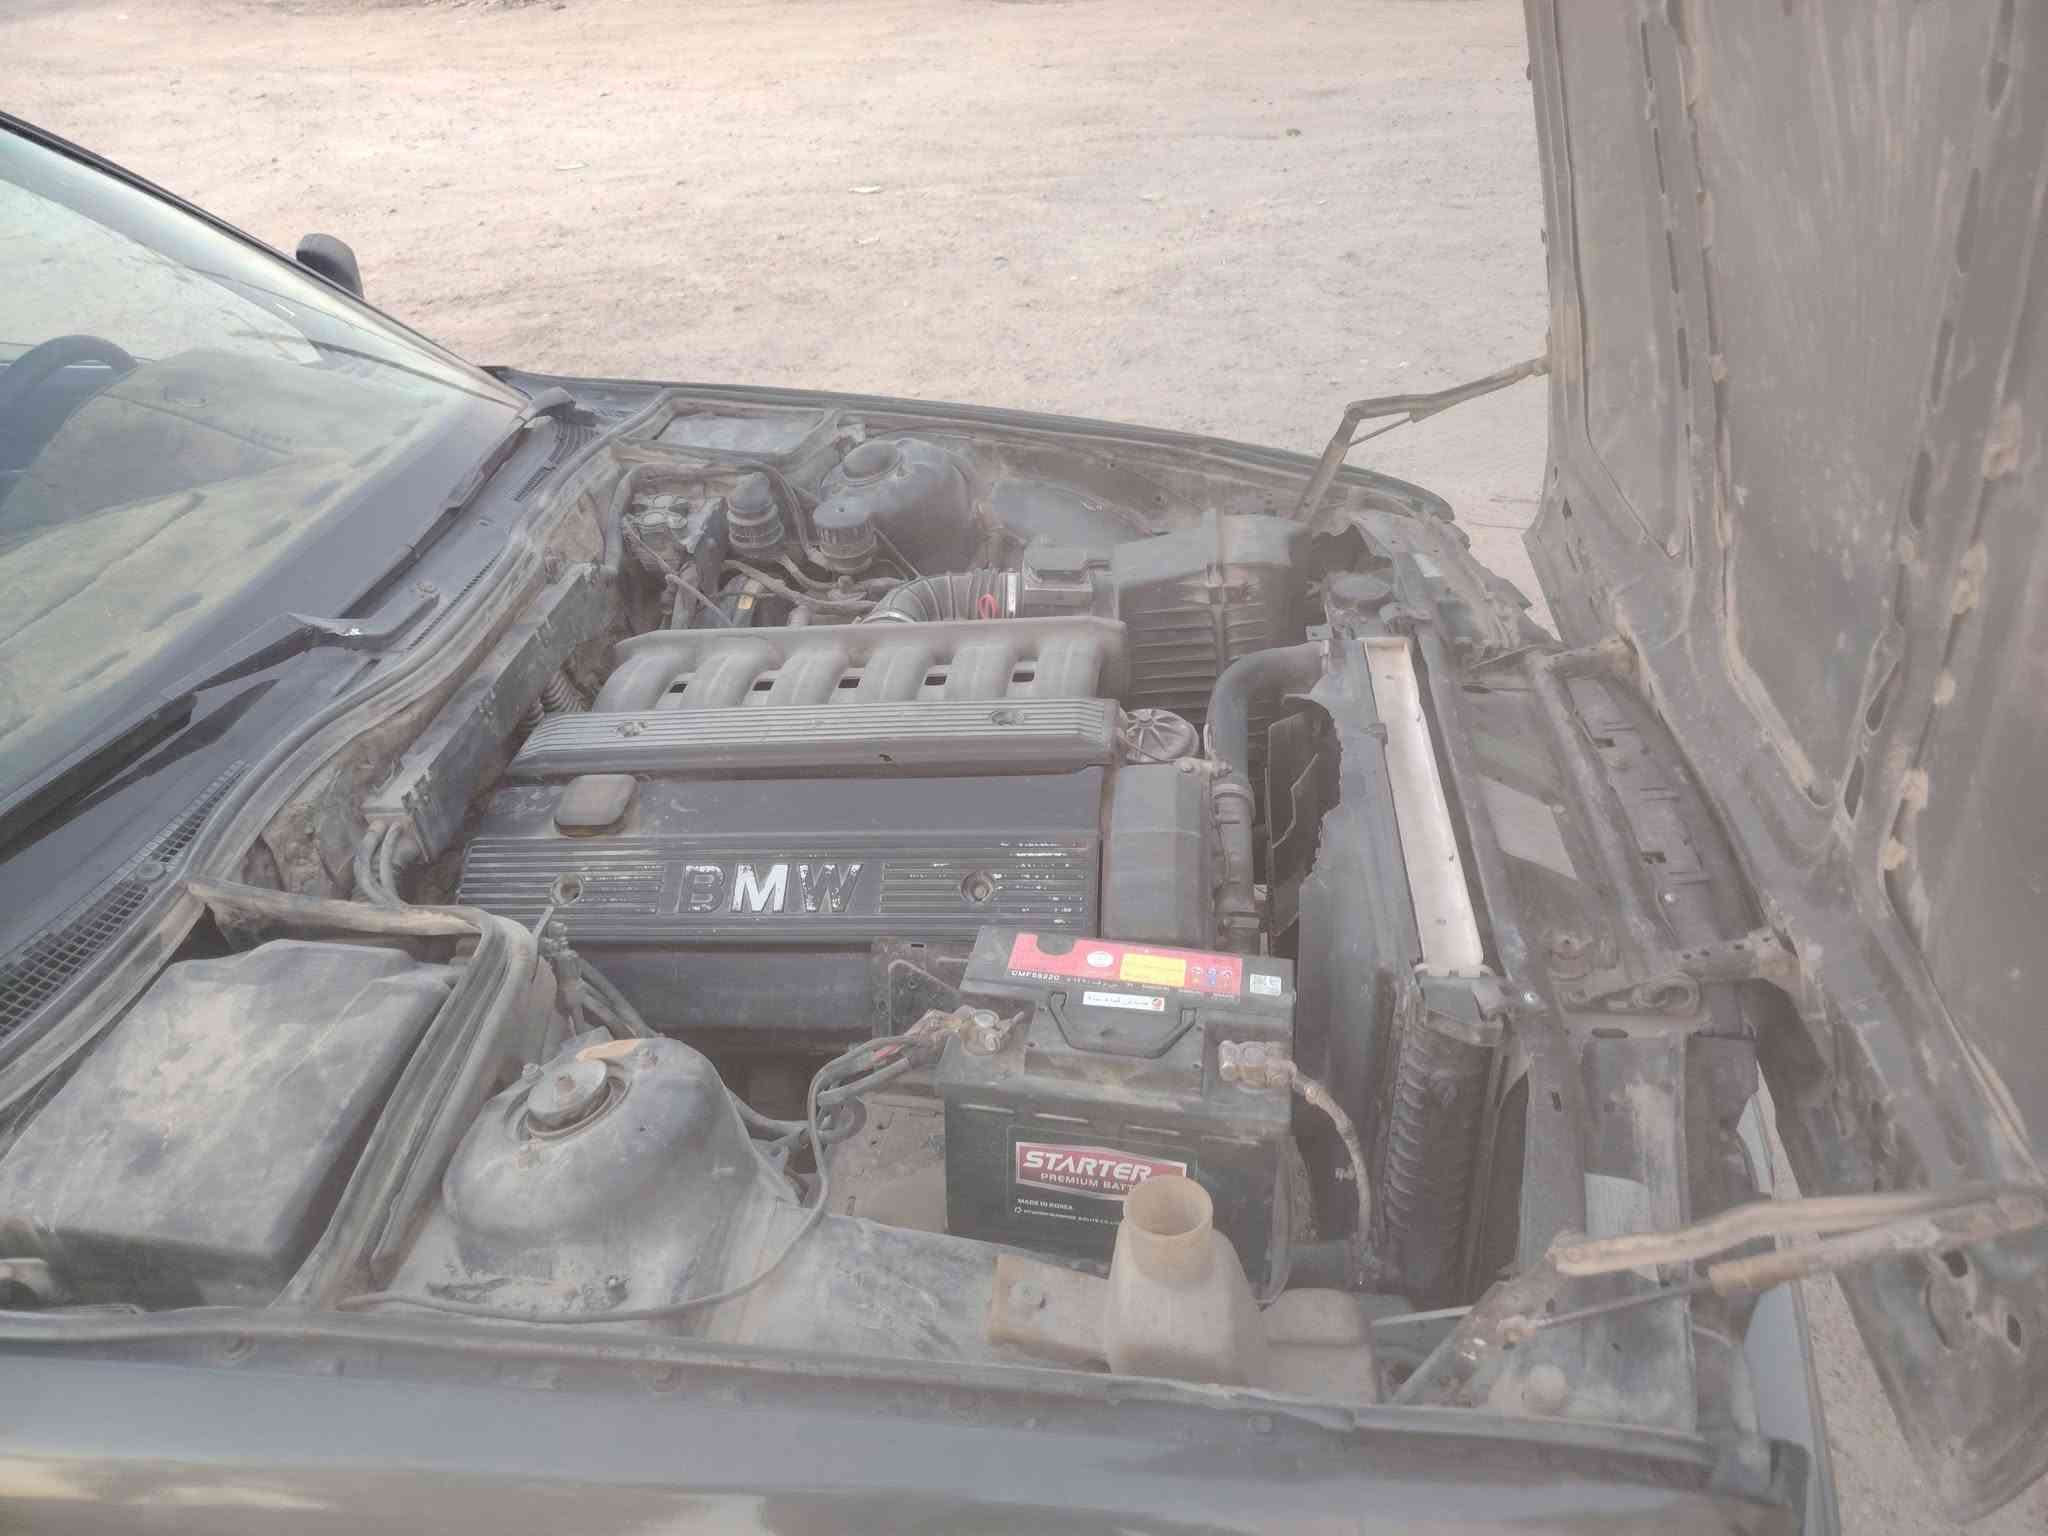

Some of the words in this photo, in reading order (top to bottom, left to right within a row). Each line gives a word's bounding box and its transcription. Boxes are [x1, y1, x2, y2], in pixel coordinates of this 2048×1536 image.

[676, 862, 864, 914] BMW
[1022, 1150, 1152, 1182] STARTER
[1040, 1172, 1099, 1188] PREMIUM
[1104, 1180, 1136, 1193] BATT
